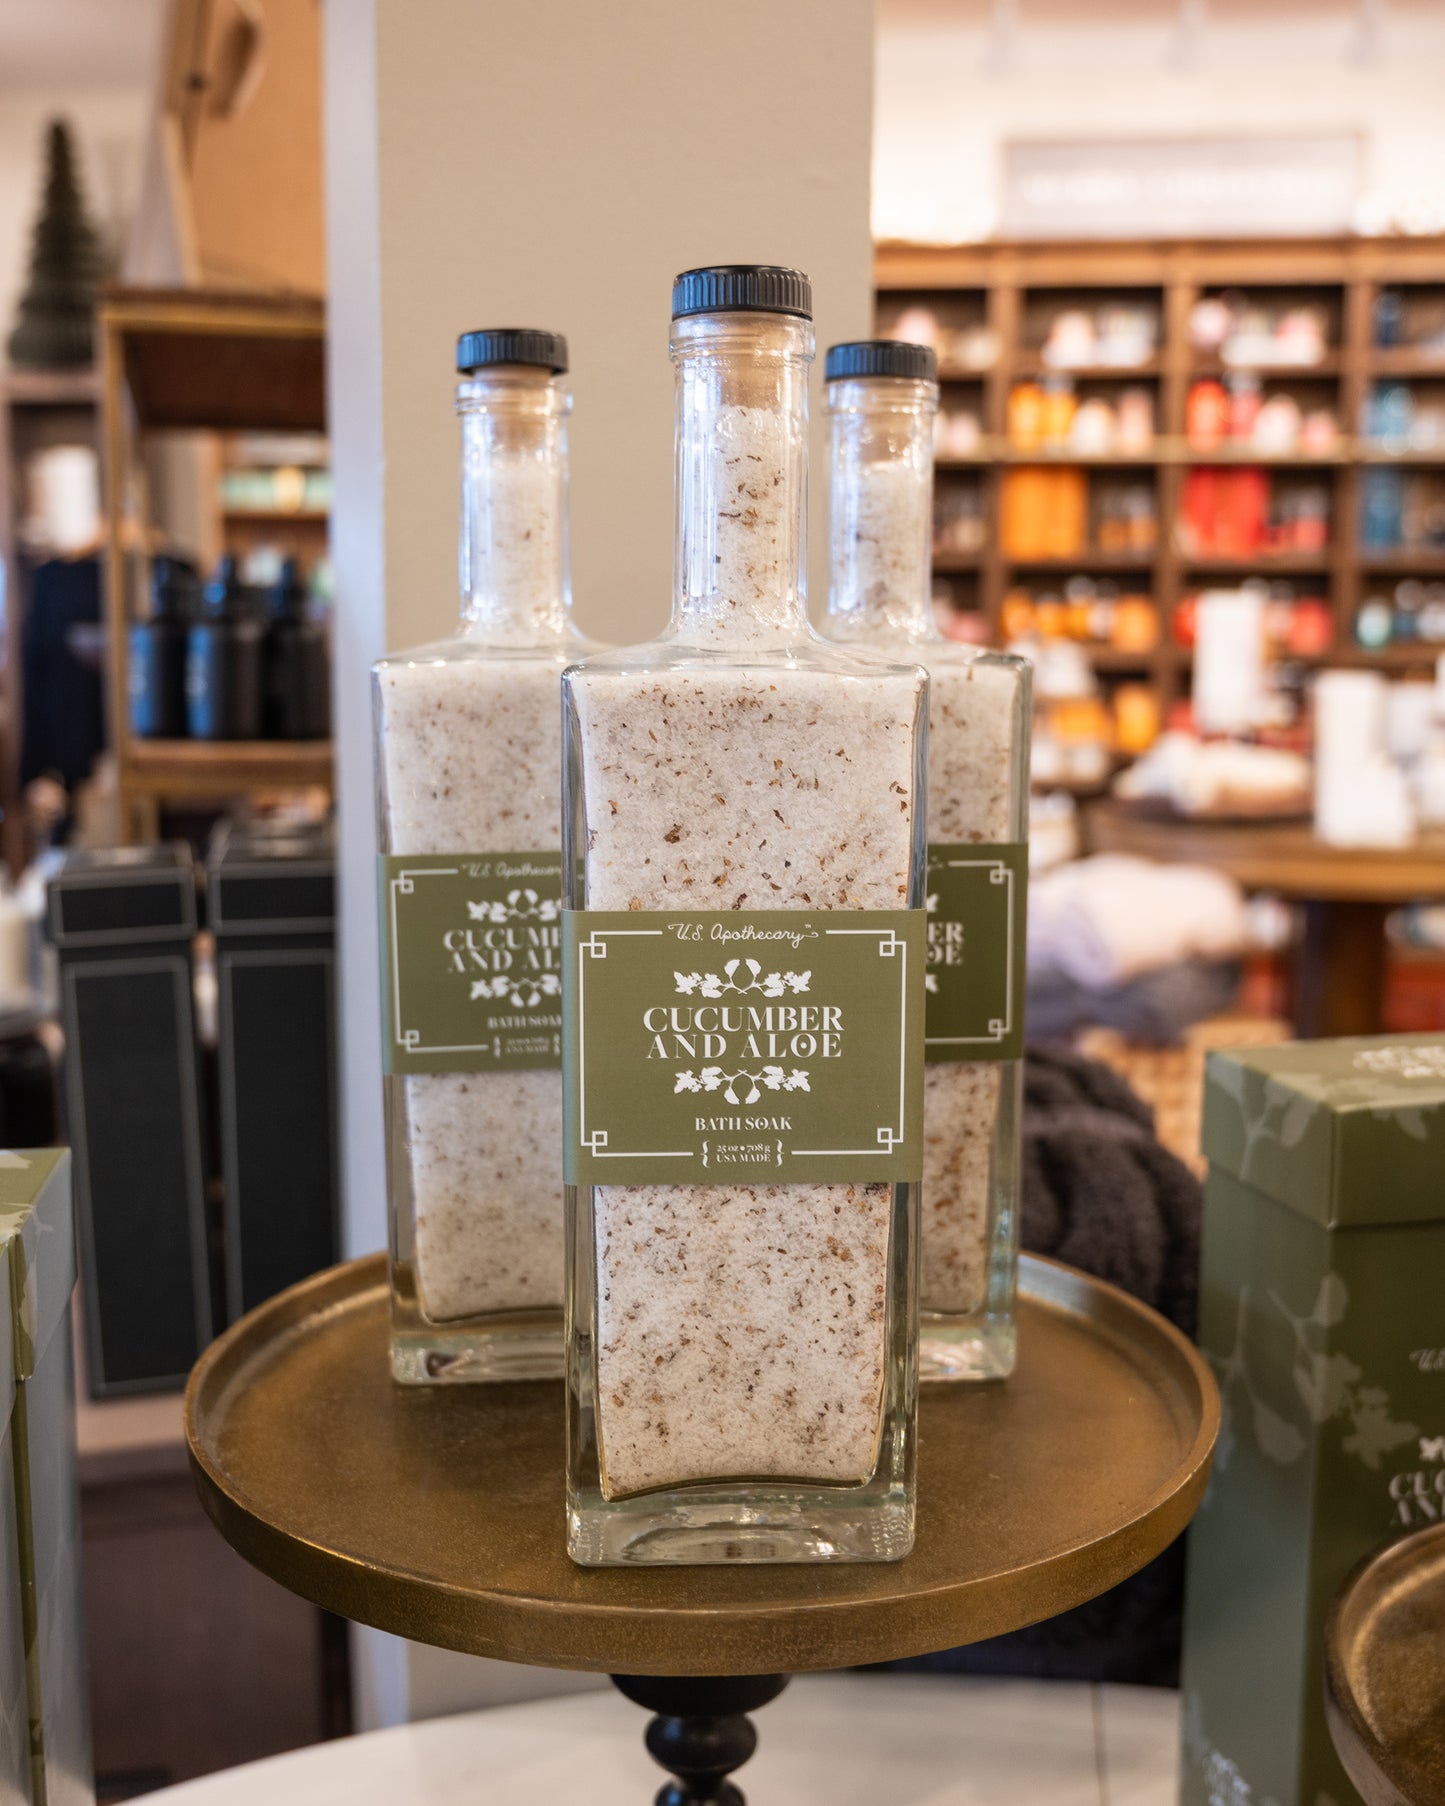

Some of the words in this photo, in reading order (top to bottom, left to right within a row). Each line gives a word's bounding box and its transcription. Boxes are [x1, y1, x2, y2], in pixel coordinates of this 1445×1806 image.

[447, 949, 513, 972] AND
[487, 1015, 526, 1029] BATH
[643, 1006, 845, 1032] CUCUMBER
[645, 1034, 727, 1059] AND
[739, 1033, 842, 1058] ALOE
[695, 1117, 741, 1131] BATH
[744, 1116, 792, 1130] SOAK
[716, 1145, 727, 1153] 25
[716, 1154, 737, 1162] USA
[740, 1154, 771, 1162] MADE
